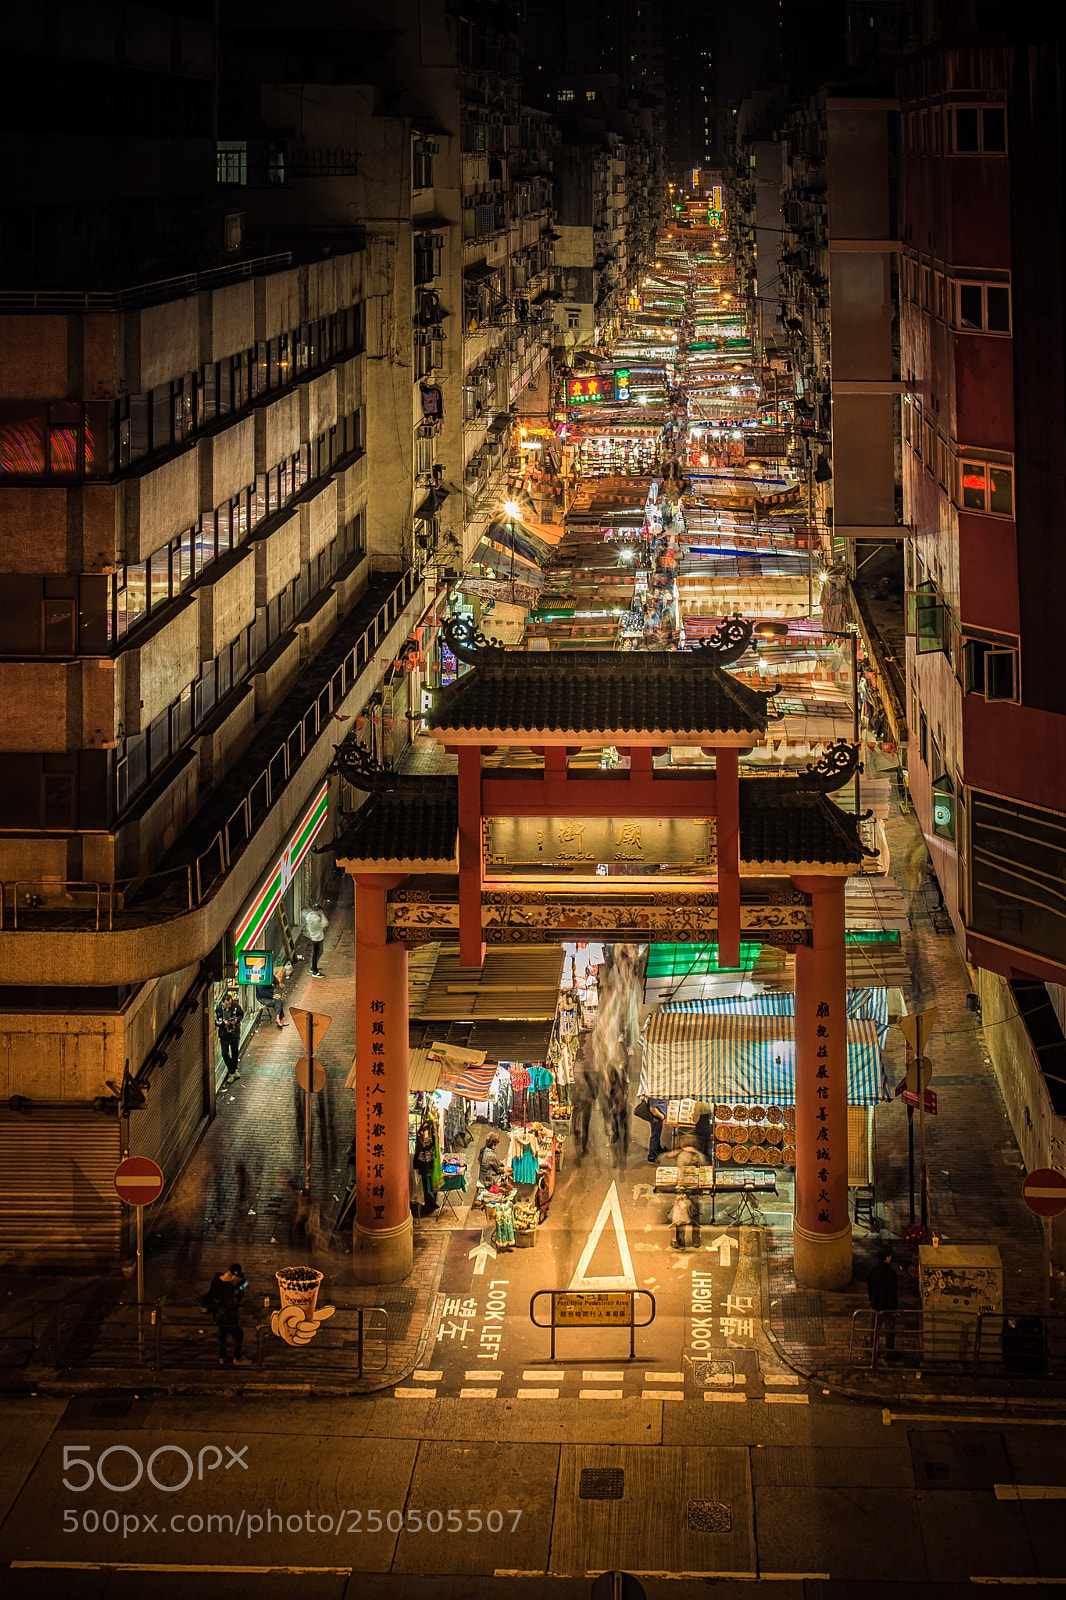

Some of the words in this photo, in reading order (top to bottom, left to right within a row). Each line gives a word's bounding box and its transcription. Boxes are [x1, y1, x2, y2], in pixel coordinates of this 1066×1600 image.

[556, 851, 596, 860] Temple
[613, 851, 645, 861] Street
[245, 957, 265, 983] 7
[487, 1280, 509, 1322] LOOK
[691, 1270, 713, 1313] RIGHT
[436, 1297, 477, 1342] 望左
[719, 1293, 755, 1340] 望右
[478, 1324, 503, 1361] LEFT
[690, 1316, 713, 1362] LOOK
